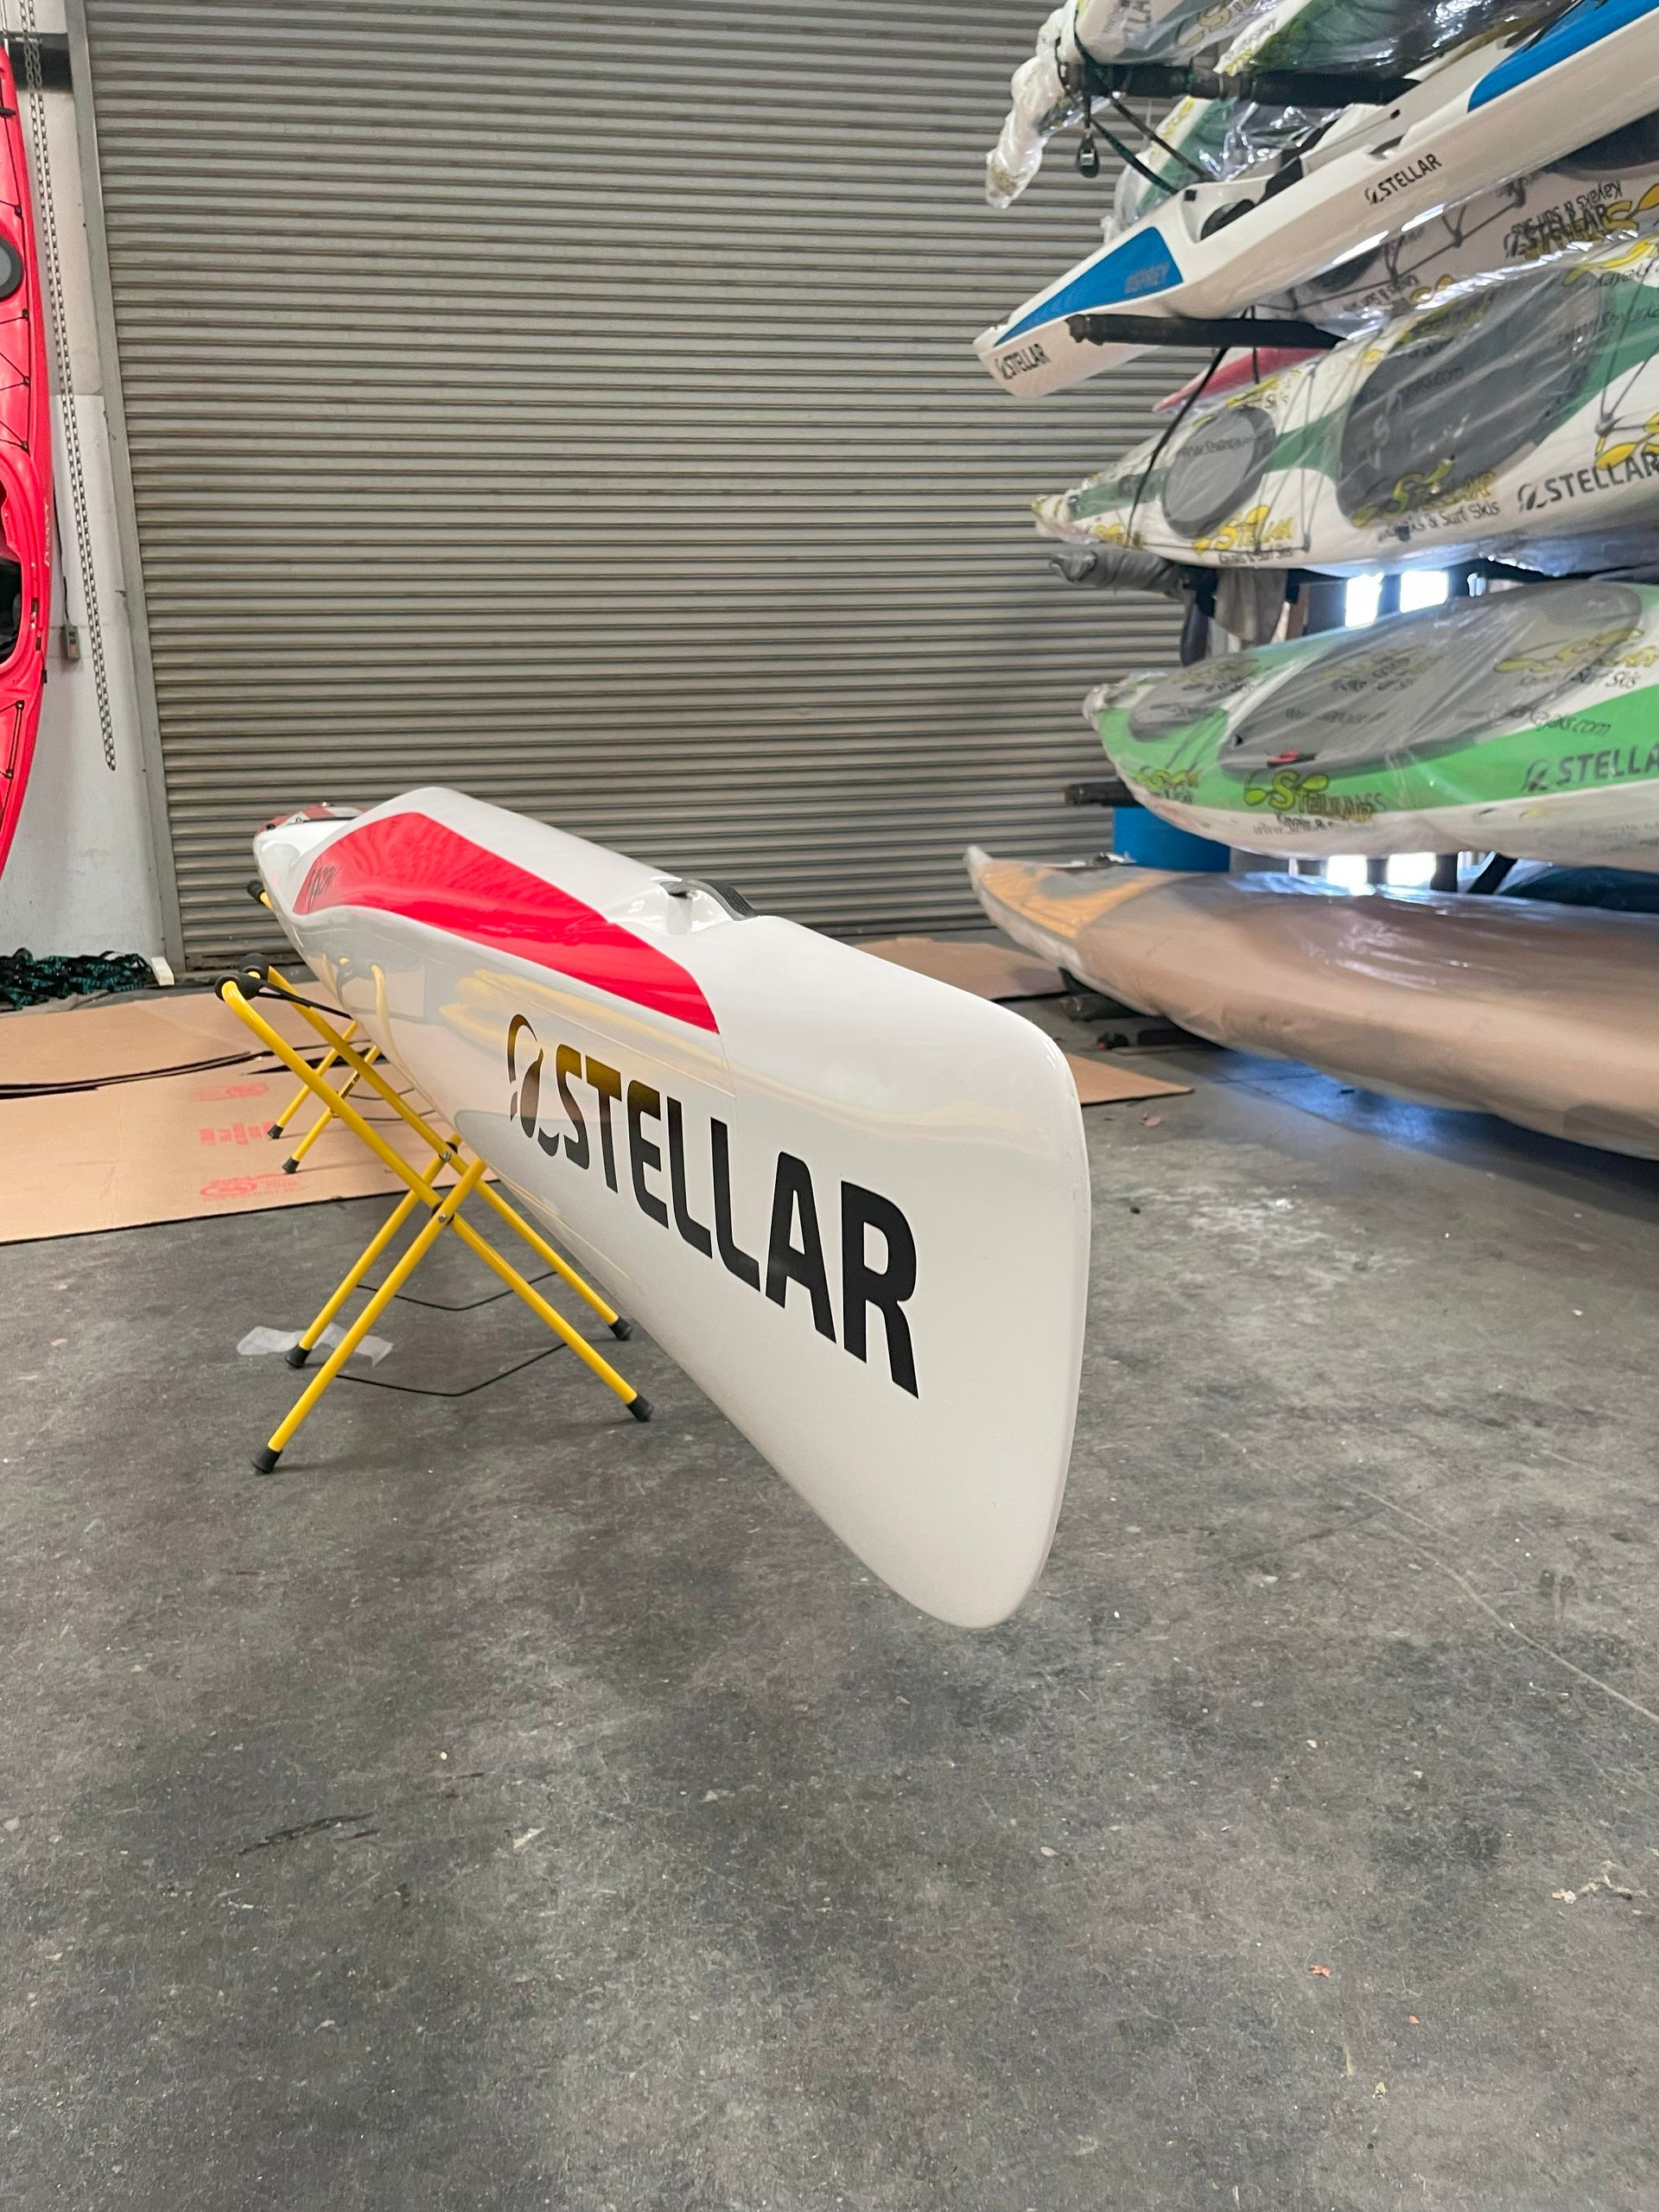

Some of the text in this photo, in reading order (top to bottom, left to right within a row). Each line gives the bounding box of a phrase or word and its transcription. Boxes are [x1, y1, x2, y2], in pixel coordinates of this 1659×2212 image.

[1378, 154, 1442, 197] STELLAR
[1575, 179, 1623, 210] Kayaks
[1545, 450, 1659, 503] STELLAR
[1469, 500, 1501, 519] Skis
[556, 1044, 918, 1399] STELLAR
